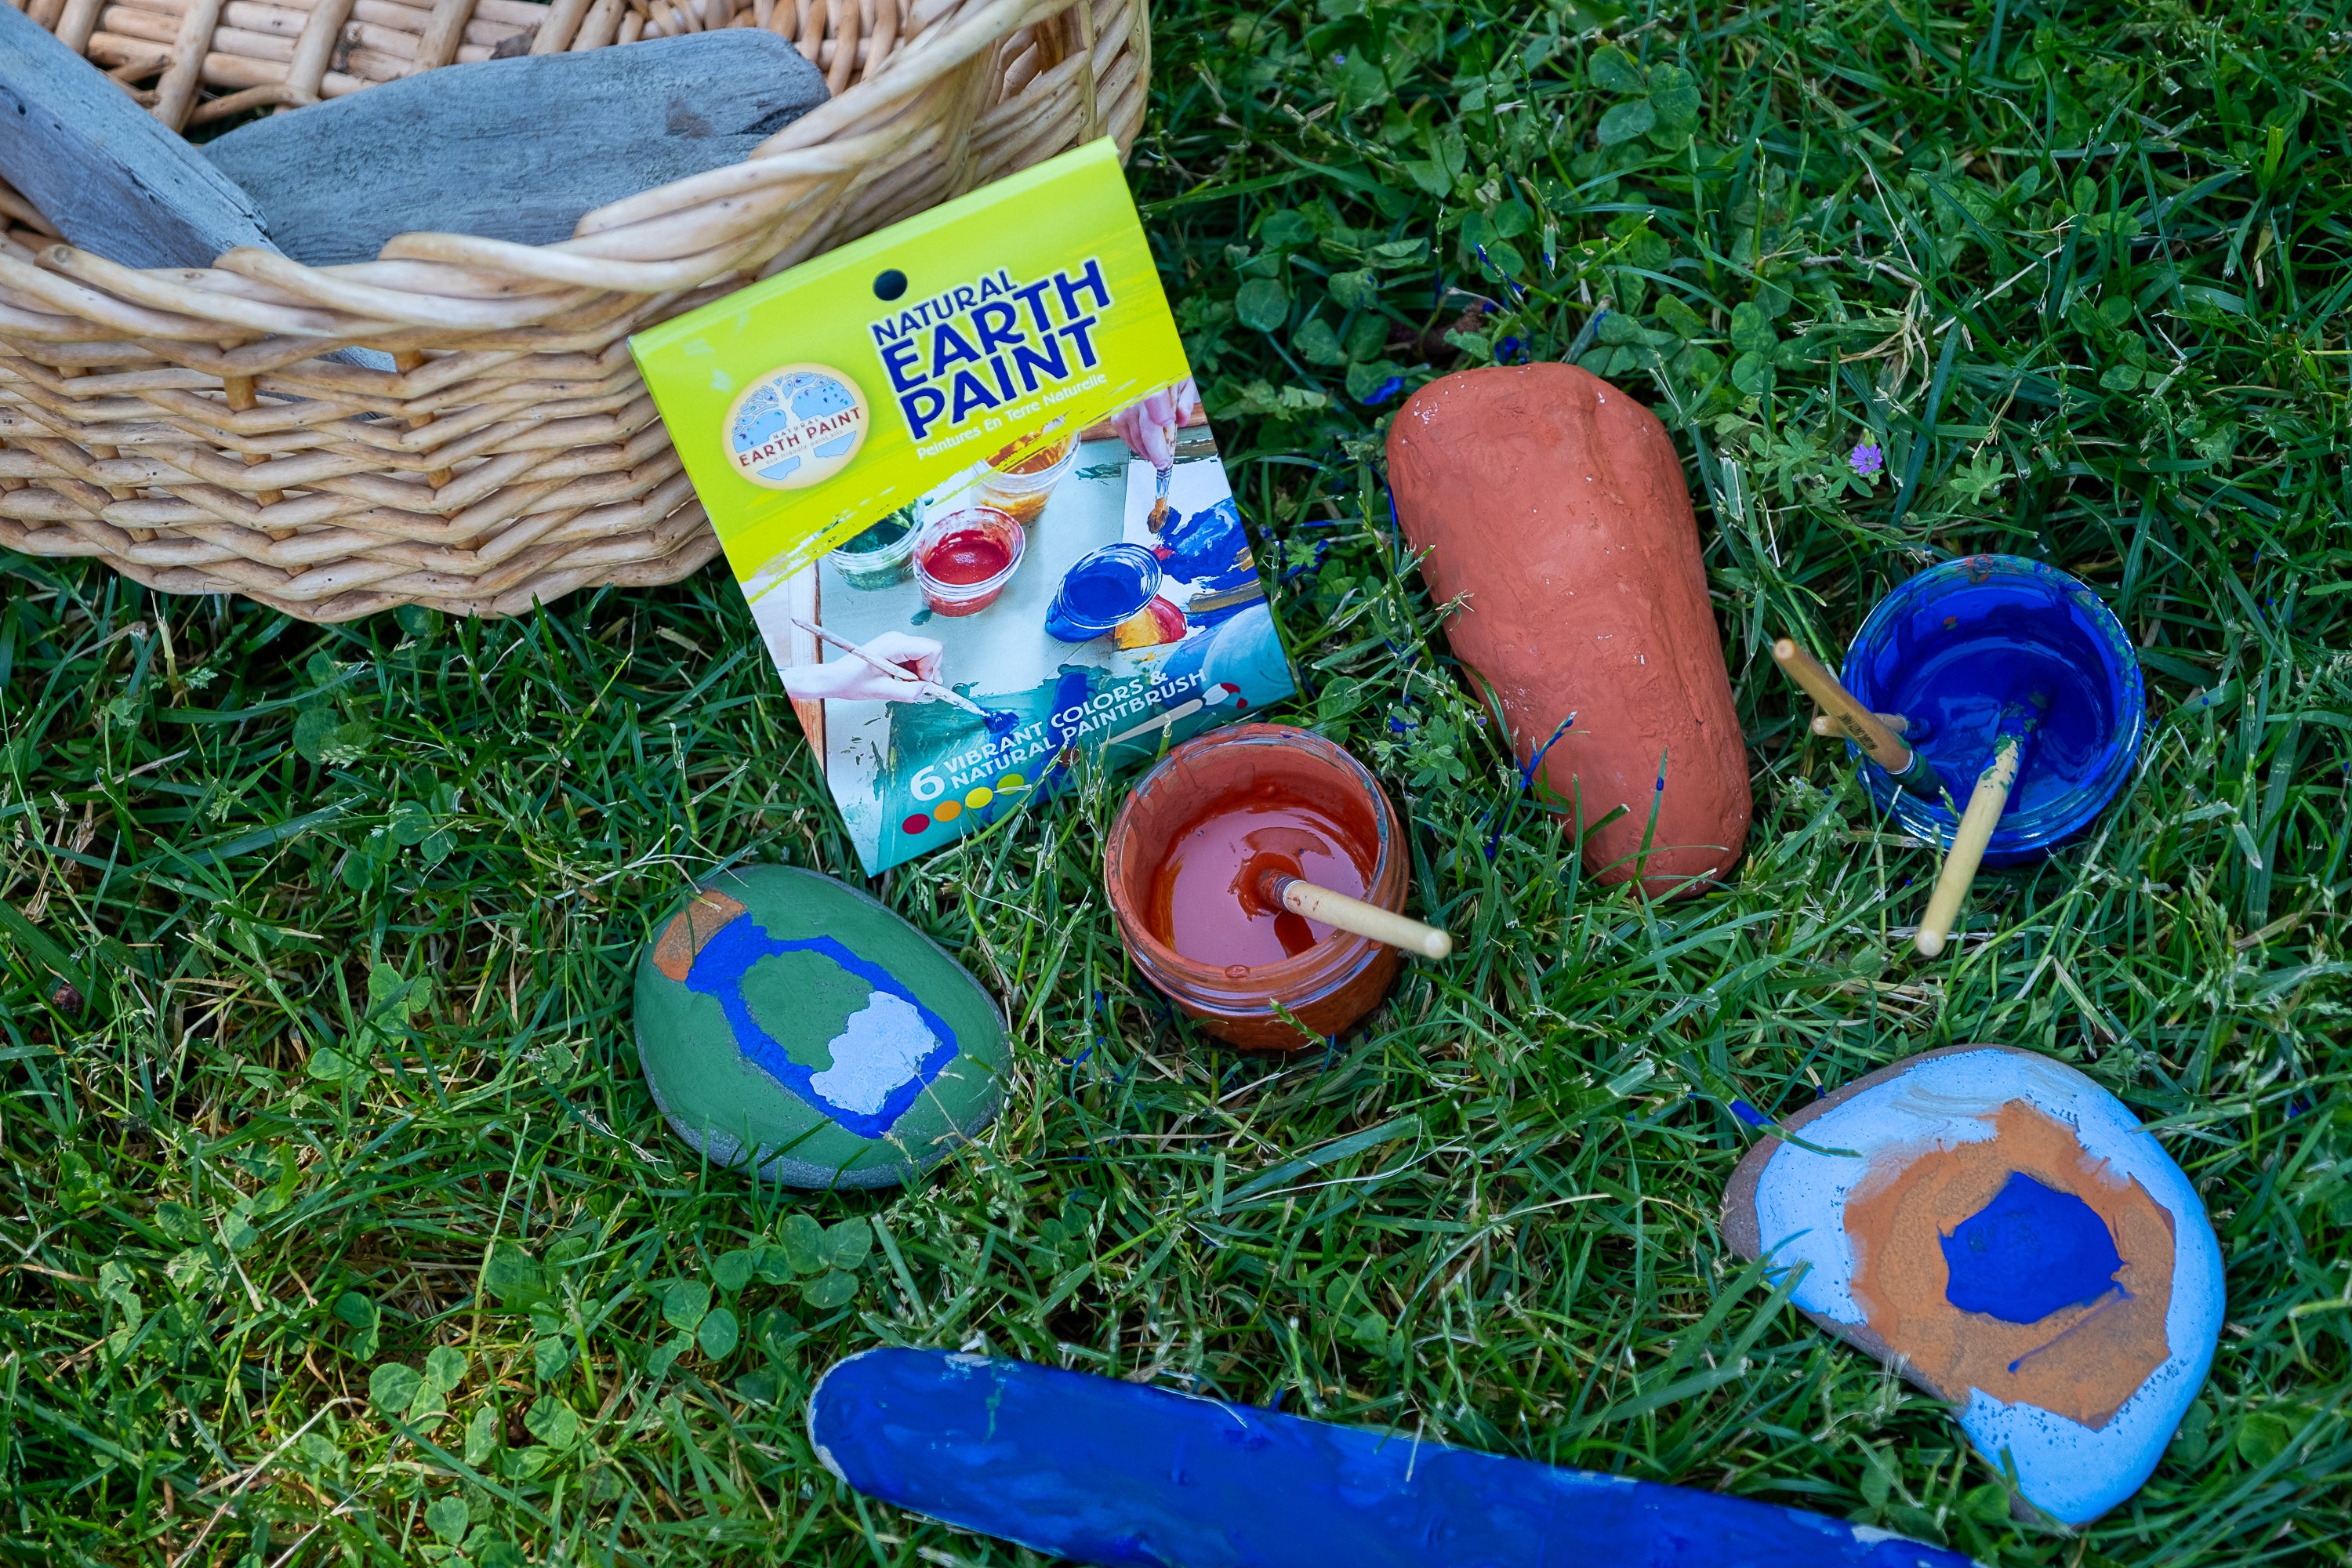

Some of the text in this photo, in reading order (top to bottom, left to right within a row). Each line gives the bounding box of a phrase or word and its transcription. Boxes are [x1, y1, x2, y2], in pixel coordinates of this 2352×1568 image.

[871, 269, 1018, 347] NATURAL
[880, 259, 1111, 394] EARTH
[773, 417, 818, 439] NATURAL
[899, 314, 1098, 440] PAINT
[916, 372, 1108, 460] Peintures En Terre Naturelle
[739, 407, 862, 467] EARTH PAINT
[910, 670, 1169, 801] 6 VIBRANT COLORS &
[950, 669, 1207, 789] NATURAL PAINTBRUSH
